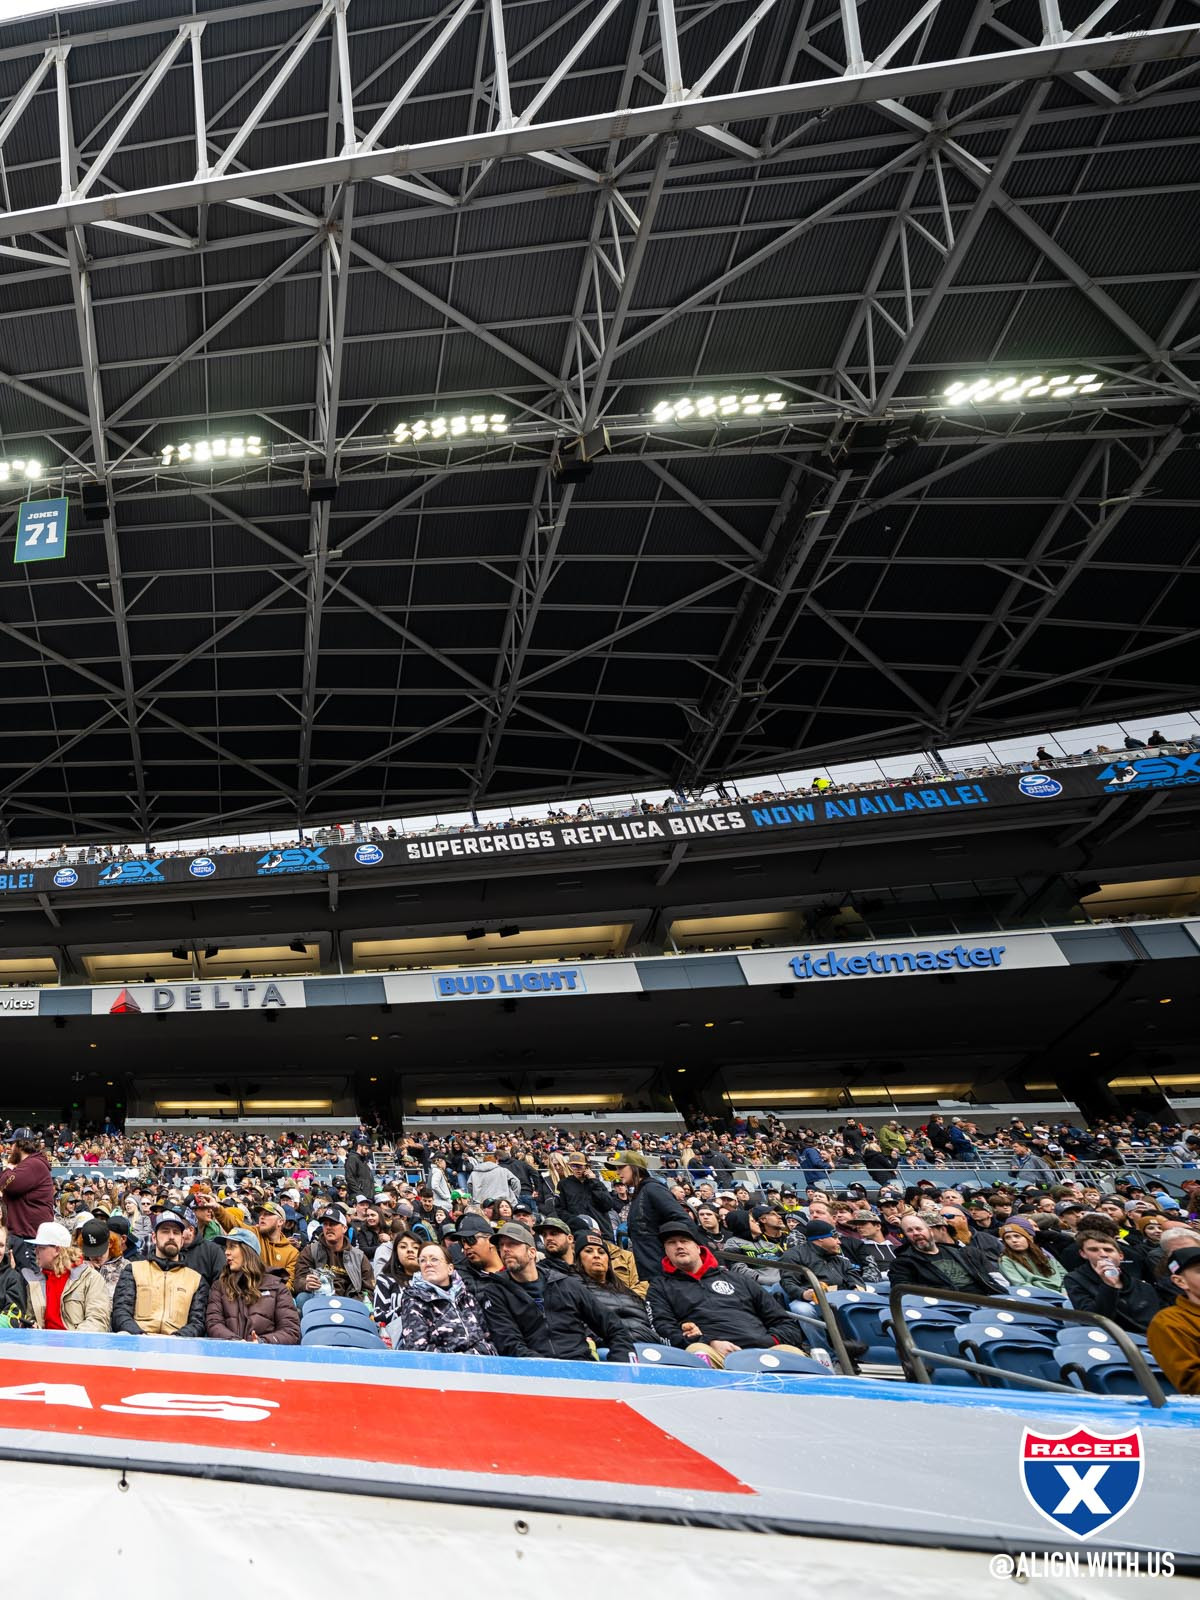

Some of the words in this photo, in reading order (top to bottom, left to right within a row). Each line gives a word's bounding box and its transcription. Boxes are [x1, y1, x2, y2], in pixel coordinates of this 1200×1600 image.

[27, 510, 59, 520] JONES
[24, 521, 58, 546] 71
[406, 829, 556, 859] SUPERCROSS
[562, 819, 664, 845] REPLICA
[667, 811, 746, 836] BIKES
[752, 803, 815, 828] NOW
[825, 784, 989, 819] AVAILABLE!
[788, 944, 1007, 979] ticketmaster
[438, 975, 495, 996] BUD
[497, 970, 578, 993] LIGHT
[153, 983, 287, 1010] DELTA
